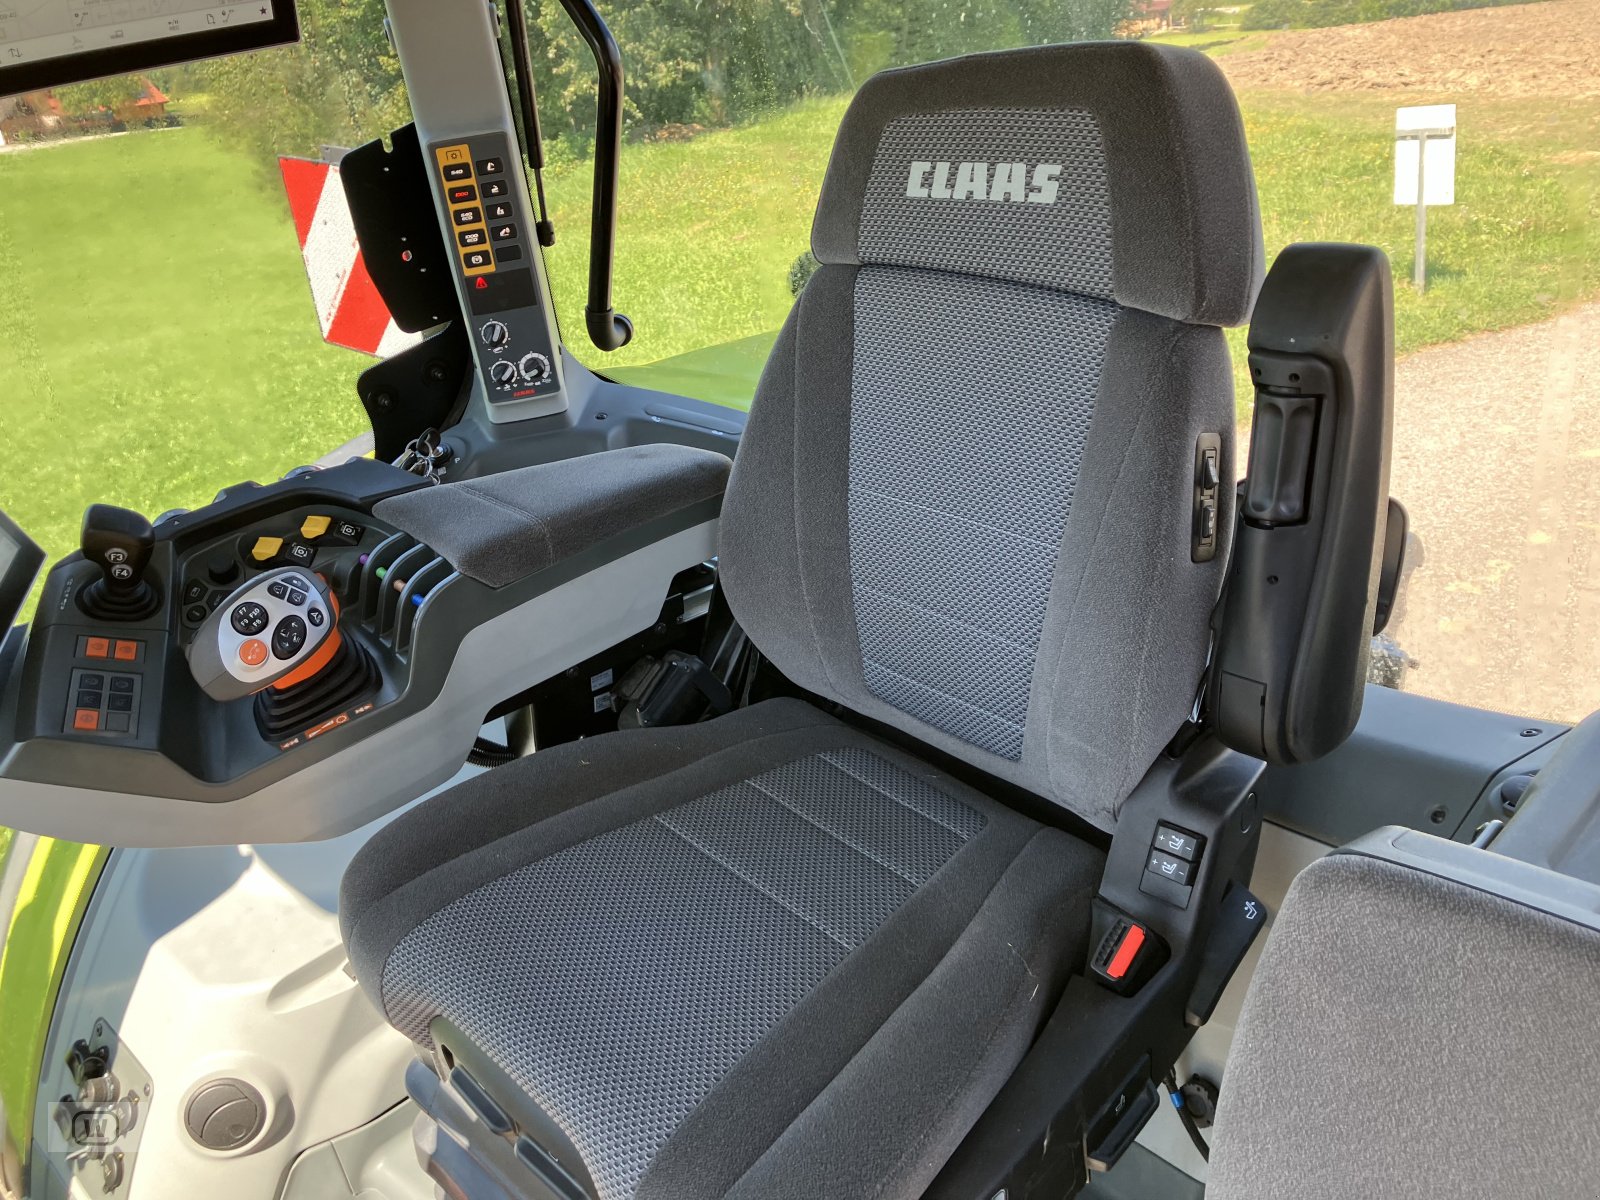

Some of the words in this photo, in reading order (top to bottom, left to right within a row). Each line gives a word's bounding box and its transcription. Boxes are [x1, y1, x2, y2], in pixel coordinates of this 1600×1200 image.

[906, 161, 1063, 203] CLAAS
[110, 553, 123, 561] F3
[115, 569, 128, 577] F4
[238, 606, 247, 615] F7
[248, 607, 260, 618] F10
[241, 618, 249, 627] F9
[252, 618, 262, 627] F8
